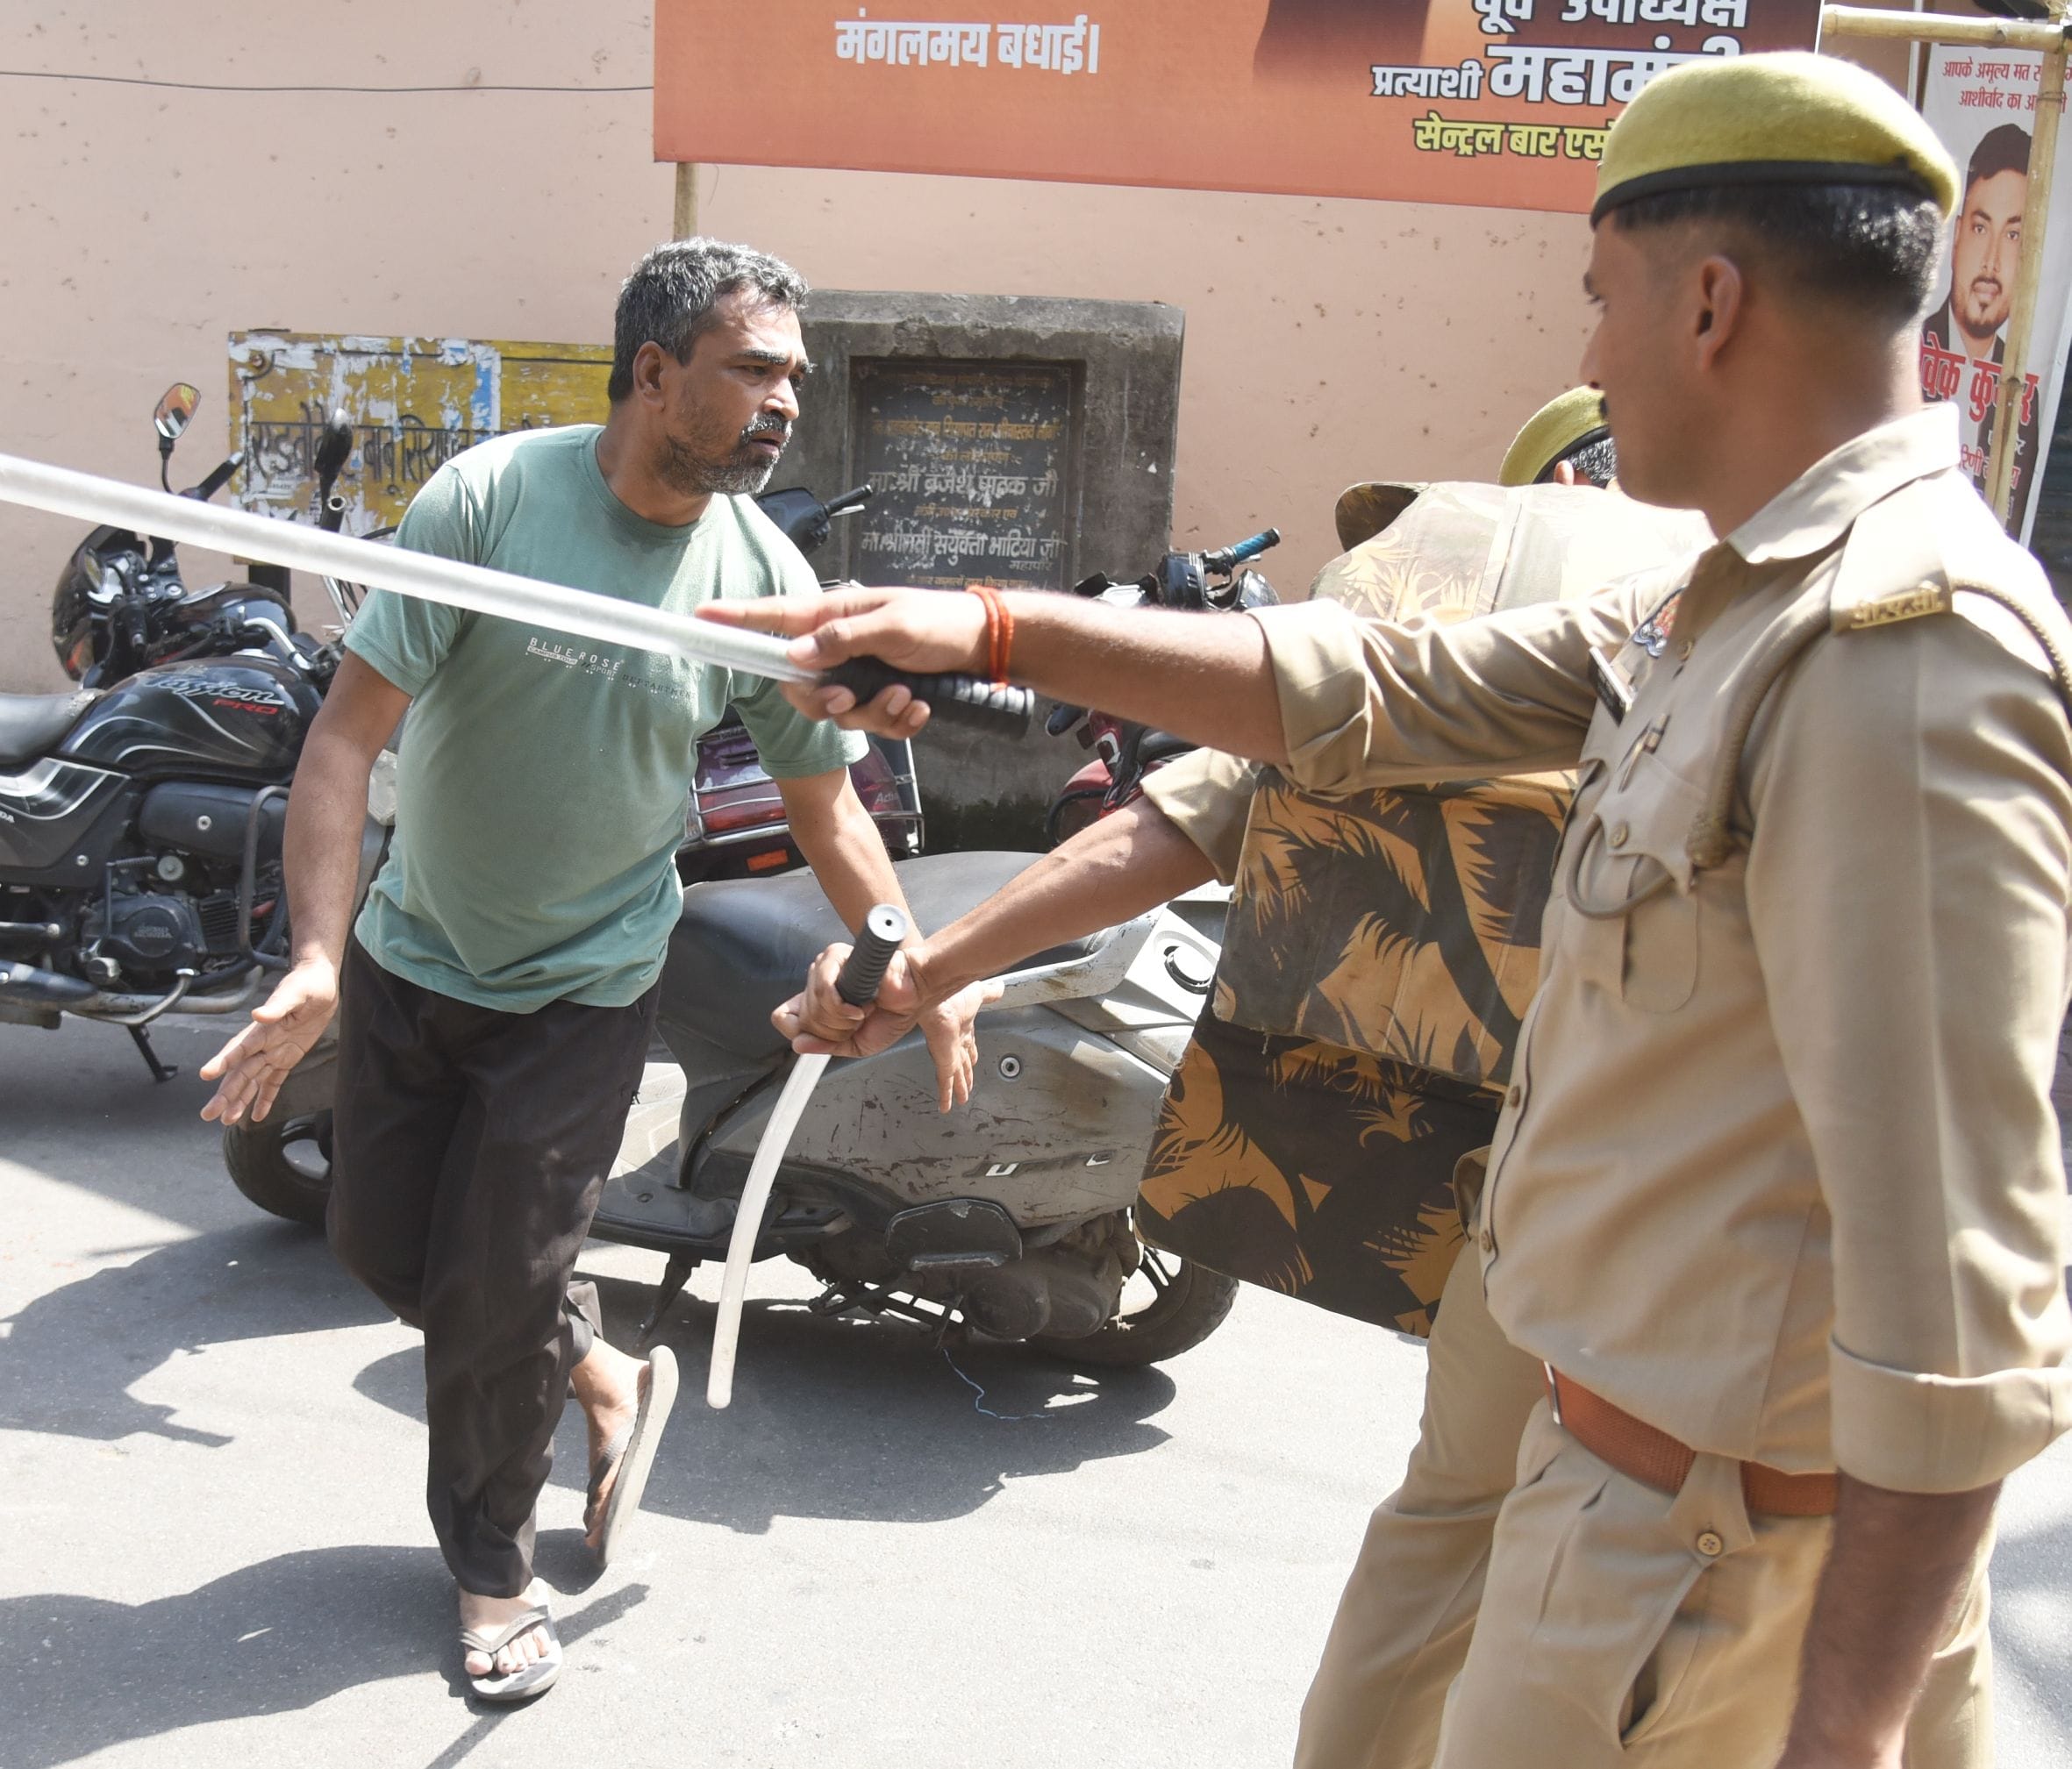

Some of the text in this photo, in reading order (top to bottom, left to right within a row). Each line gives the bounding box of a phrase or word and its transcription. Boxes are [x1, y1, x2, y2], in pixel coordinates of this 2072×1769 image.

[835, 7, 991, 68] मंगलमय
[1371, 60, 1483, 99] प्रत्याशी
[1943, 56, 1973, 78] आपके
[1976, 62, 2010, 84] अमूल्य
[2013, 64, 2031, 82] मत
[1959, 86, 2004, 110] आशीर्वाद
[2007, 93, 2022, 111] का
[1414, 112, 1505, 155] सेन्ट्रल
[1508, 125, 1560, 157] बार
[1032, 469, 1058, 496] जी
[530, 637, 621, 672] BLUE ROSE
[213, 699, 278, 715] PRO
